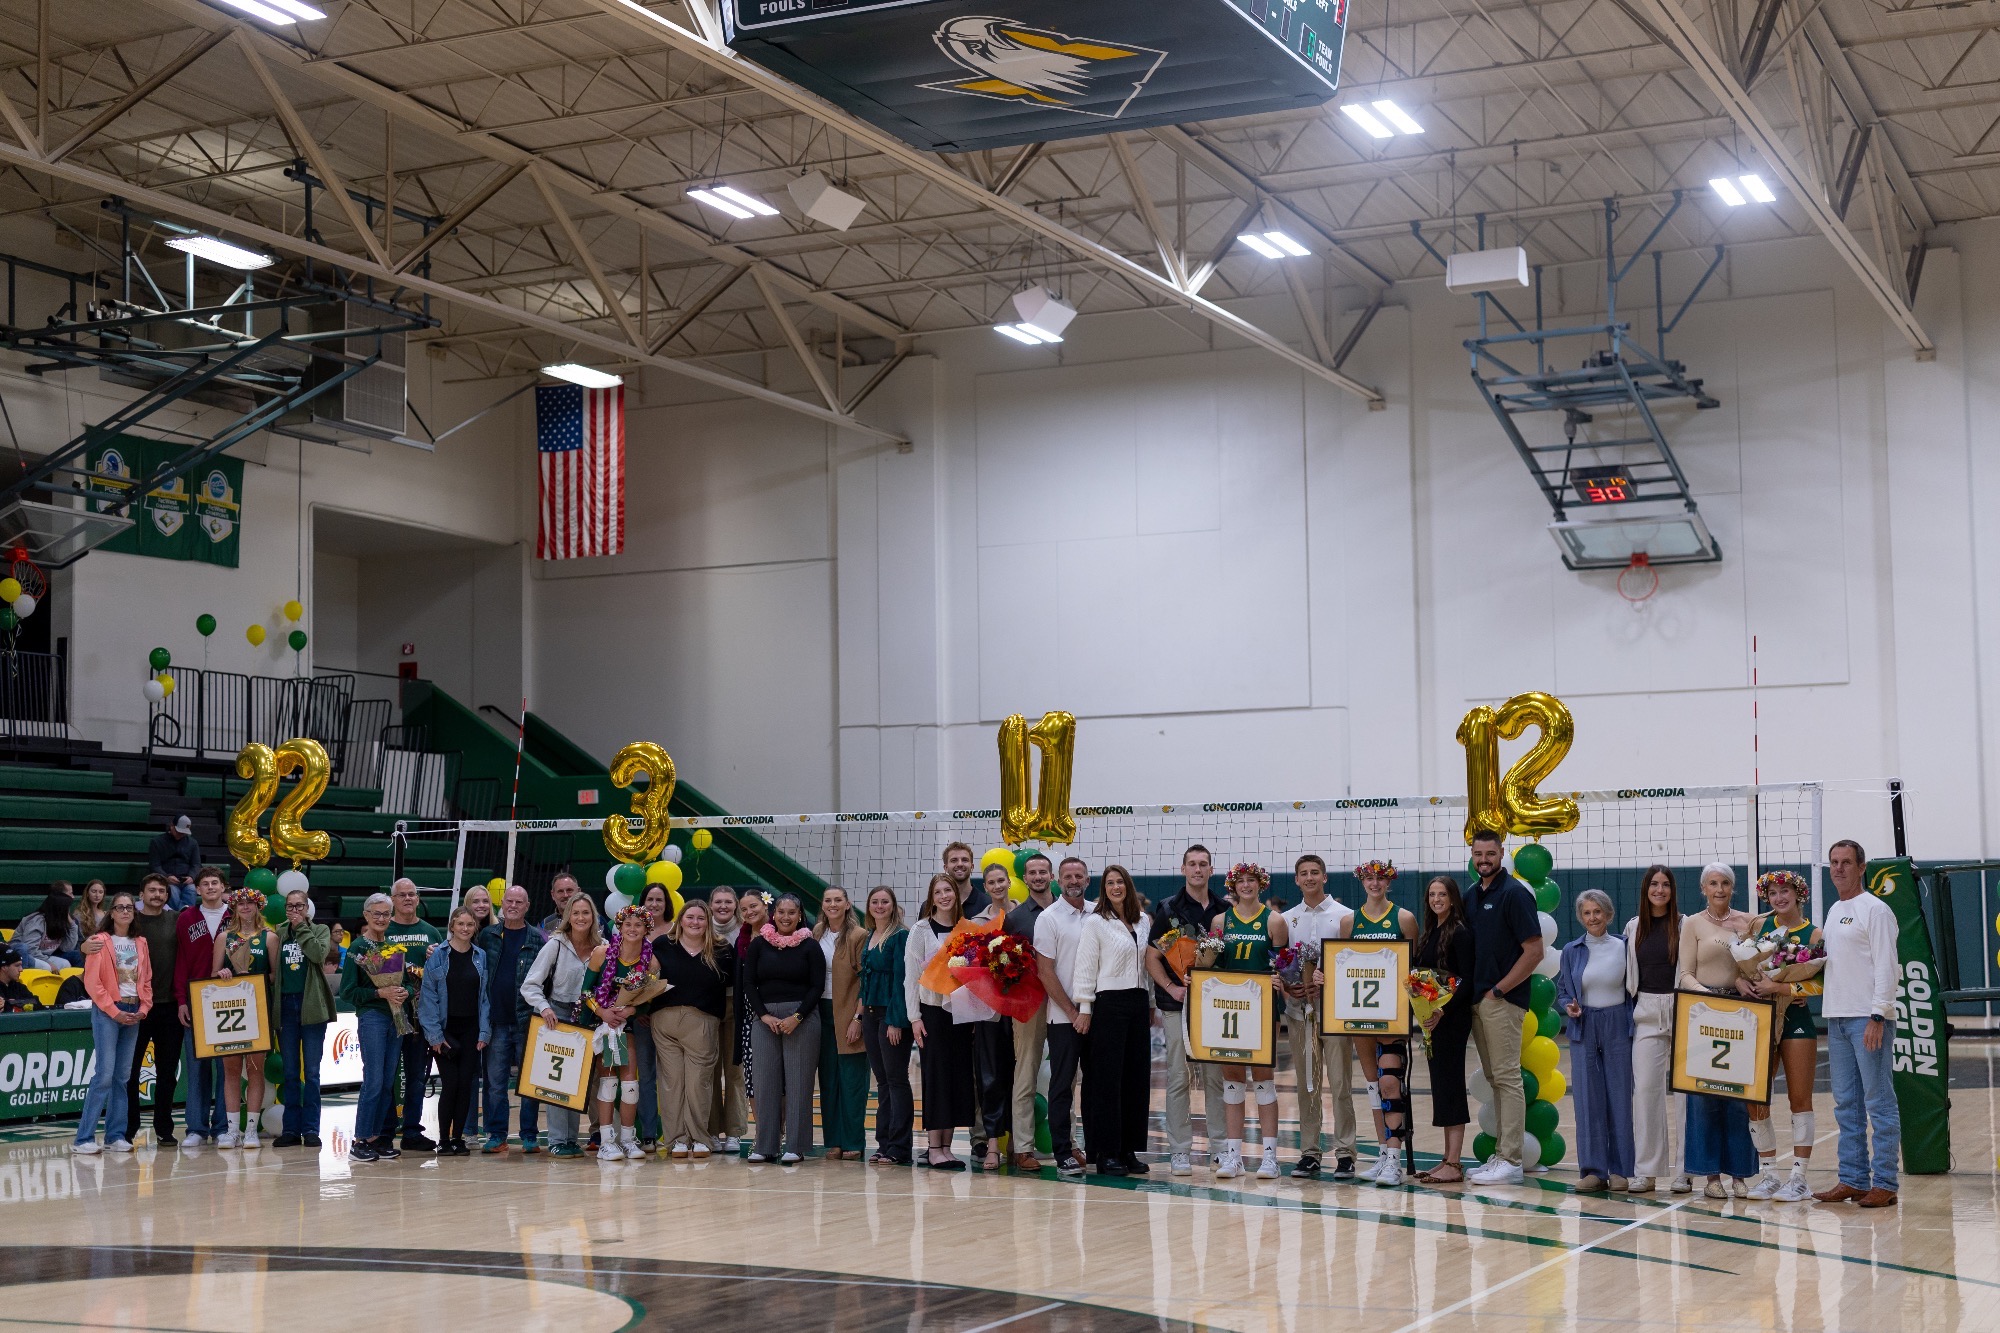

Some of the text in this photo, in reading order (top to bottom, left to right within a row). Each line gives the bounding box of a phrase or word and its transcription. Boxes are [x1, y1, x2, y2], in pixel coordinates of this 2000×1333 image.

[760, 0, 806, 15] FOULS
[1318, 40, 1332, 61] TEAM
[1315, 53, 1332, 75] FOULS
[1585, 486, 1626, 503] 30
[1456, 691, 1580, 846] 12
[997, 711, 1076, 847] 11
[1617, 787, 1685, 799] CONCORDIA
[227, 737, 330, 866] 22
[602, 741, 676, 863] 3
[1203, 802, 1263, 812] CONCORDIA
[1336, 798, 1398, 809] CONCORDIA
[835, 812, 889, 822] CONCORDIA
[952, 810, 1001, 819] CONCORDI
[1075, 805, 1134, 816] CONCORDIA
[516, 820, 558, 830] ONCORDIA
[723, 815, 774, 825] CONCORDIA
[388, 934, 429, 943] CONCORDIA
[1235, 941, 1253, 960] 11
[285, 955, 305, 964] NEST
[1346, 968, 1386, 978] CONCORDIA
[1351, 980, 1380, 1008] 12
[212, 998, 247, 1010] CONCORDIA
[1213, 999, 1250, 1010] CONCORDIA
[215, 1008, 247, 1033] 22
[1221, 1011, 1240, 1039] 11
[1892, 963, 1914, 1074] GLES
[1905, 960, 1939, 1077] GOLDEN
[1700, 1025, 1744, 1040] CONCORDIA
[543, 1042, 575, 1058] CONCORDIA
[1711, 1039, 1731, 1070] 2
[548, 1055, 565, 1081] 3
[9, 1088, 89, 1106] GOLDEN EAG
